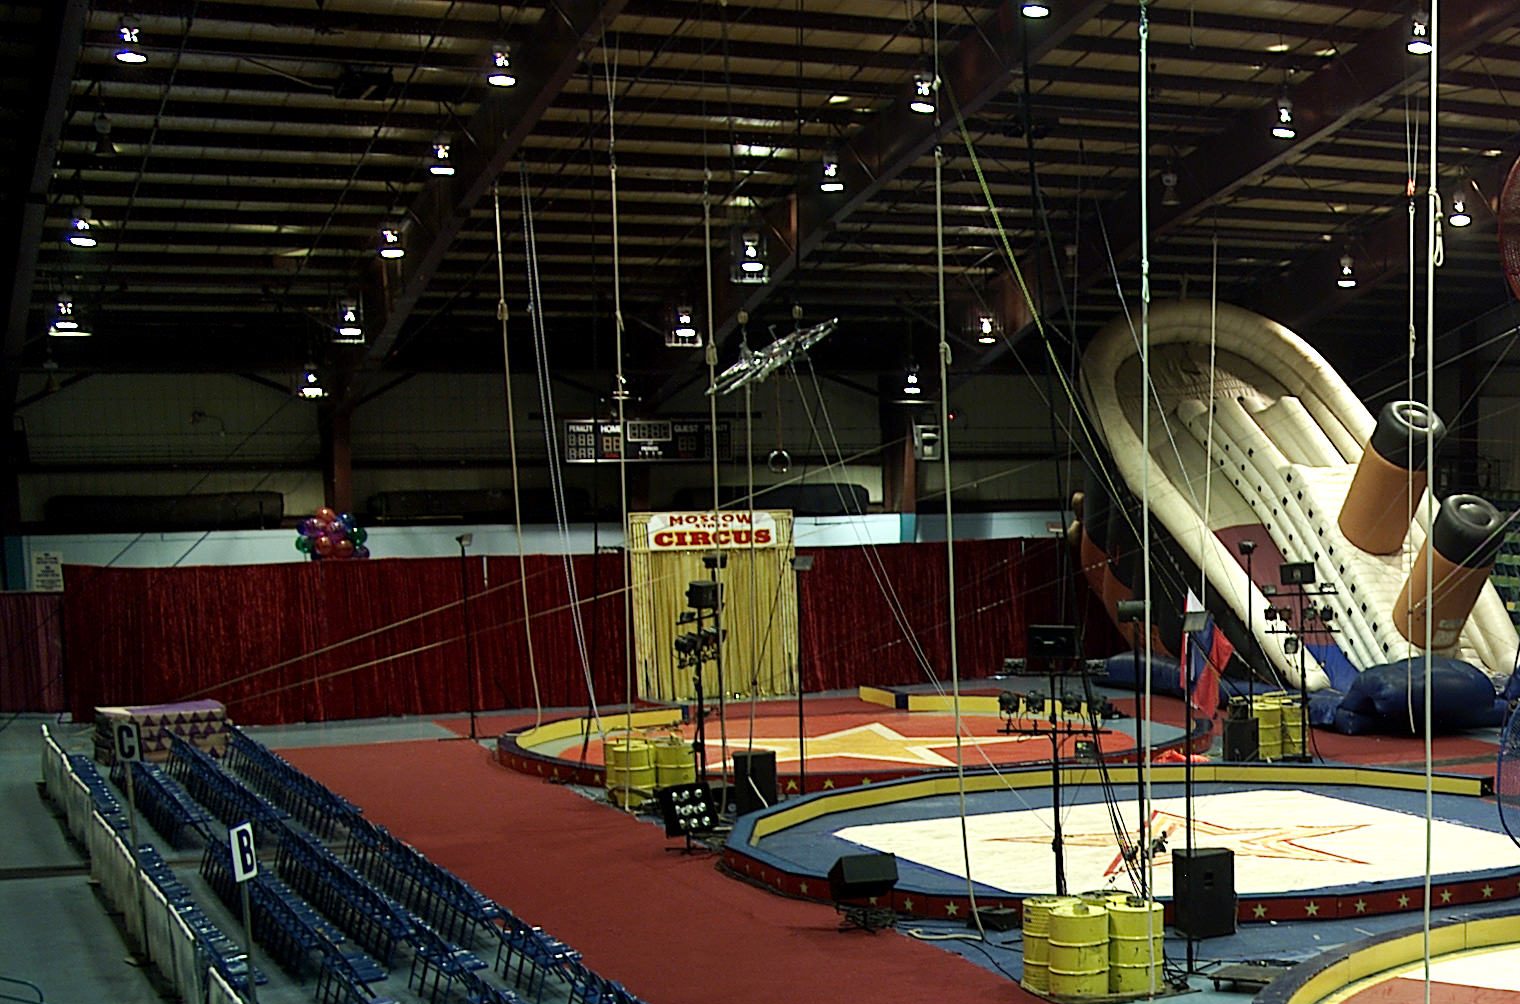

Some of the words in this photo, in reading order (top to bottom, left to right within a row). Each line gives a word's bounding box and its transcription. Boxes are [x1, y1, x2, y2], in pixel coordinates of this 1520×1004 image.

[674, 424, 698, 433] GUEST
[669, 513, 752, 527] MOSCOW
[654, 529, 771, 546] CIRCUS
[118, 725, 136, 759] C
[237, 828, 255, 875] B
